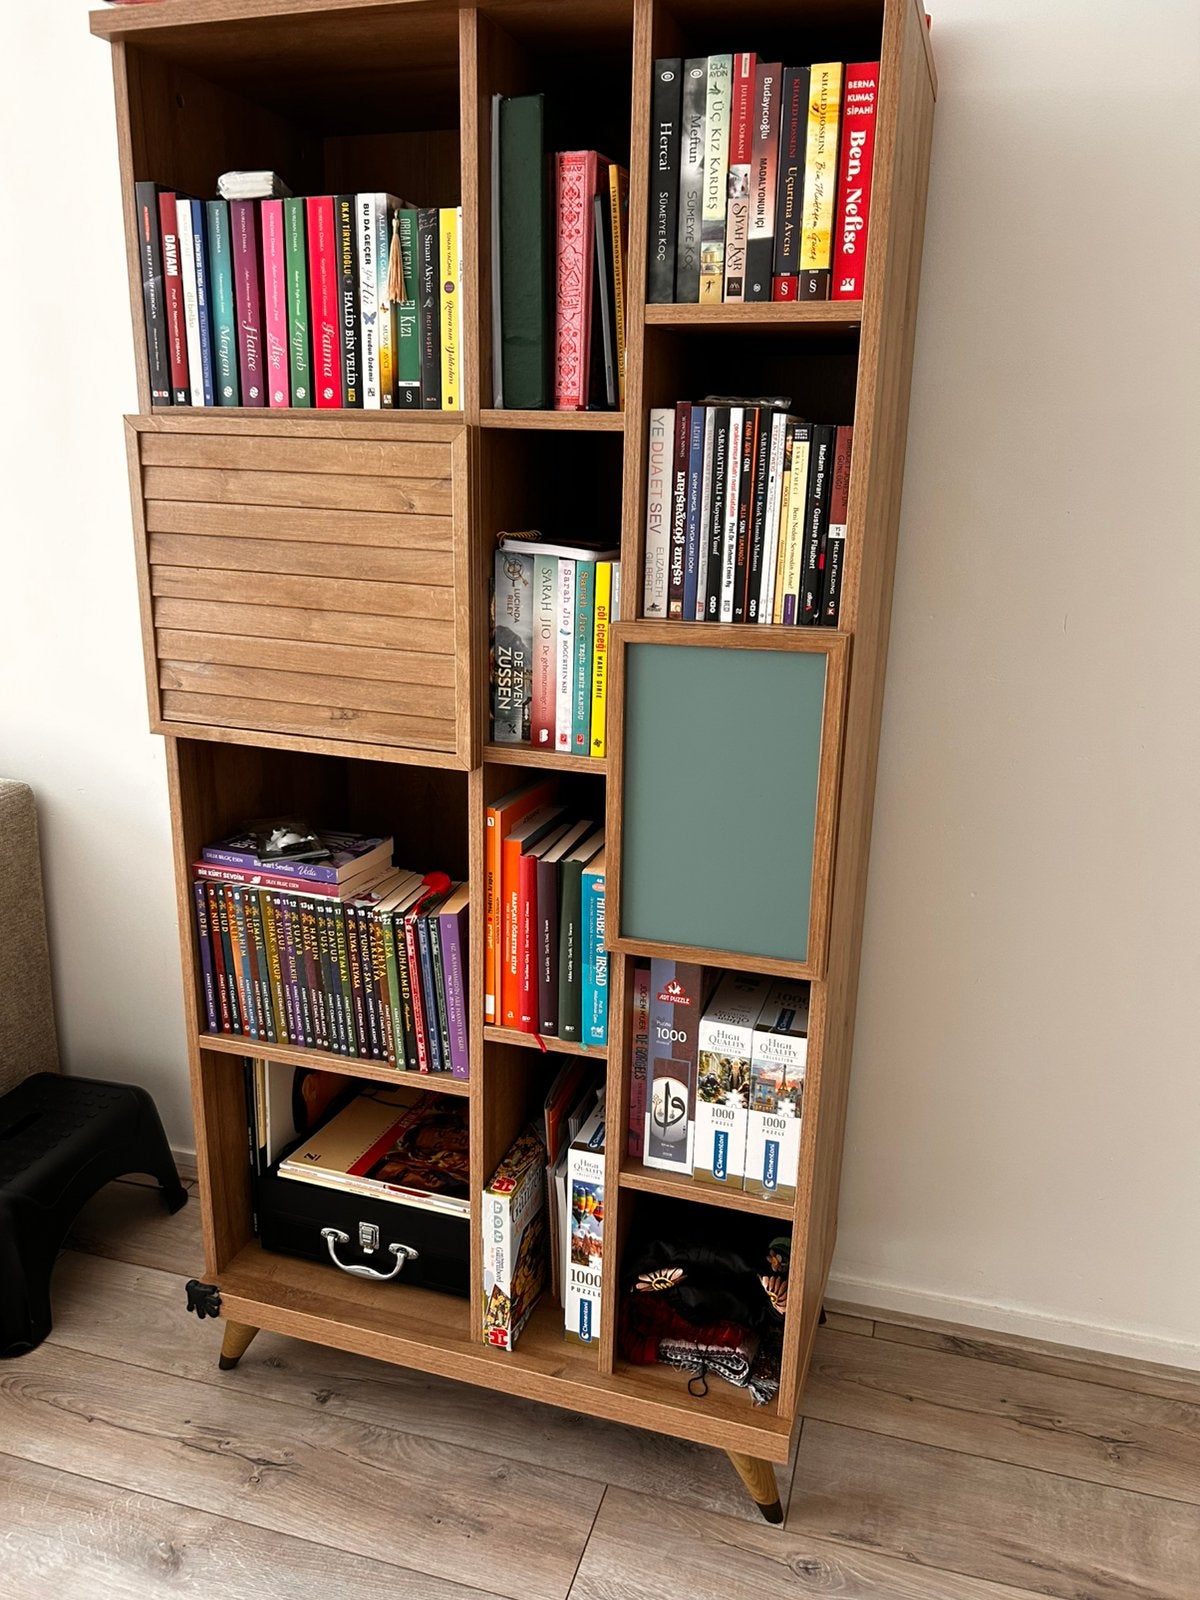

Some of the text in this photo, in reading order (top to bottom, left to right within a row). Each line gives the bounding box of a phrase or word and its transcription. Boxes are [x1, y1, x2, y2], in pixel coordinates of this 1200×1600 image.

[820, 72, 829, 110] KHALED
[847, 79, 875, 88] BERNA
[847, 93, 874, 102] KUMAŞ
[760, 77, 773, 140] Budayıcıoğlu
[847, 104, 873, 116] SİPAHİ
[659, 122, 673, 171] Hercai
[688, 114, 701, 164] Meftun
[707, 101, 724, 210] ÜÇ KIZ KARDEŞ
[756, 158, 768, 215] MADALYONUN
[842, 130, 867, 254] Ben, Nefise
[378, 213, 387, 241] ALLAH
[657, 192, 669, 261] SÜMEYYE KOÇ
[686, 190, 698, 242] SÜMEYYE
[783, 167, 798, 256] Uçurtma Avcısı
[342, 202, 354, 274] OKAY TİRYAKİOĞLU
[362, 203, 372, 265] BU DA GEÇER
[400, 218, 412, 249] ORHAN
[164, 234, 178, 276] DAVAM
[424, 234, 435, 293] Sinan Akyüz
[727, 243, 745, 271] KAR
[344, 291, 358, 385] HALİD BİN VELİD
[400, 315, 416, 337] Kızı
[219, 325, 232, 377] Meryem
[242, 320, 258, 372] Hatice
[292, 319, 306, 371] Zeyneb
[649, 415, 665, 534] YE DUA ET SEV
[712, 428, 726, 555] SABAHATTİN ALİ Kuyucaklı Yusuf
[757, 482, 765, 494] ALİ
[792, 507, 800, 520] Beni
[809, 444, 827, 569] Madam Bovary Gustave Flaubert
[672, 471, 686, 585] aşkın gözyaşları
[791, 522, 799, 543] Neden
[655, 547, 664, 597] ELIZABETH
[752, 544, 761, 571] Madonna
[829, 541, 840, 594] HELEN FIELDING
[506, 594, 514, 616] RILEY
[513, 588, 521, 623] LUCINDA
[540, 567, 553, 639] SARAH JIO
[562, 568, 572, 625] Sarah Jio
[579, 571, 589, 632] Sarah Jio
[596, 606, 607, 652] çöl çiçeği
[498, 646, 512, 710] ZUSSEN
[513, 651, 523, 708] DE ZEVEN
[223, 873, 244, 881] SEVDİM
[199, 911, 207, 937] ADEM
[211, 912, 219, 932] NUH
[220, 913, 228, 932] HUD
[276, 922, 285, 951] YUSUF
[302, 925, 311, 951] MUSA
[310, 927, 319, 960] HARUN
[328, 930, 337, 962] DAVUD
[360, 934, 369, 961] YUNUS
[376, 940, 386, 977] YAHYA
[397, 942, 410, 999] MUHAMMED
[670, 996, 690, 1004] PUZZLE
[635, 1034, 648, 1044] DE
[656, 1027, 687, 1042] 1000
[708, 1034, 745, 1048] QUALITY
[717, 1029, 740, 1041] HIGH
[760, 1043, 798, 1057] QUALITY
[768, 1038, 792, 1050] HIGH
[711, 1107, 734, 1120] 1000
[762, 1116, 786, 1129] 1000
[579, 1158, 599, 1169] HIGH
[716, 1134, 724, 1169] Clementoni
[766, 1143, 775, 1179] Clementoni
[570, 1268, 601, 1288] 1000
